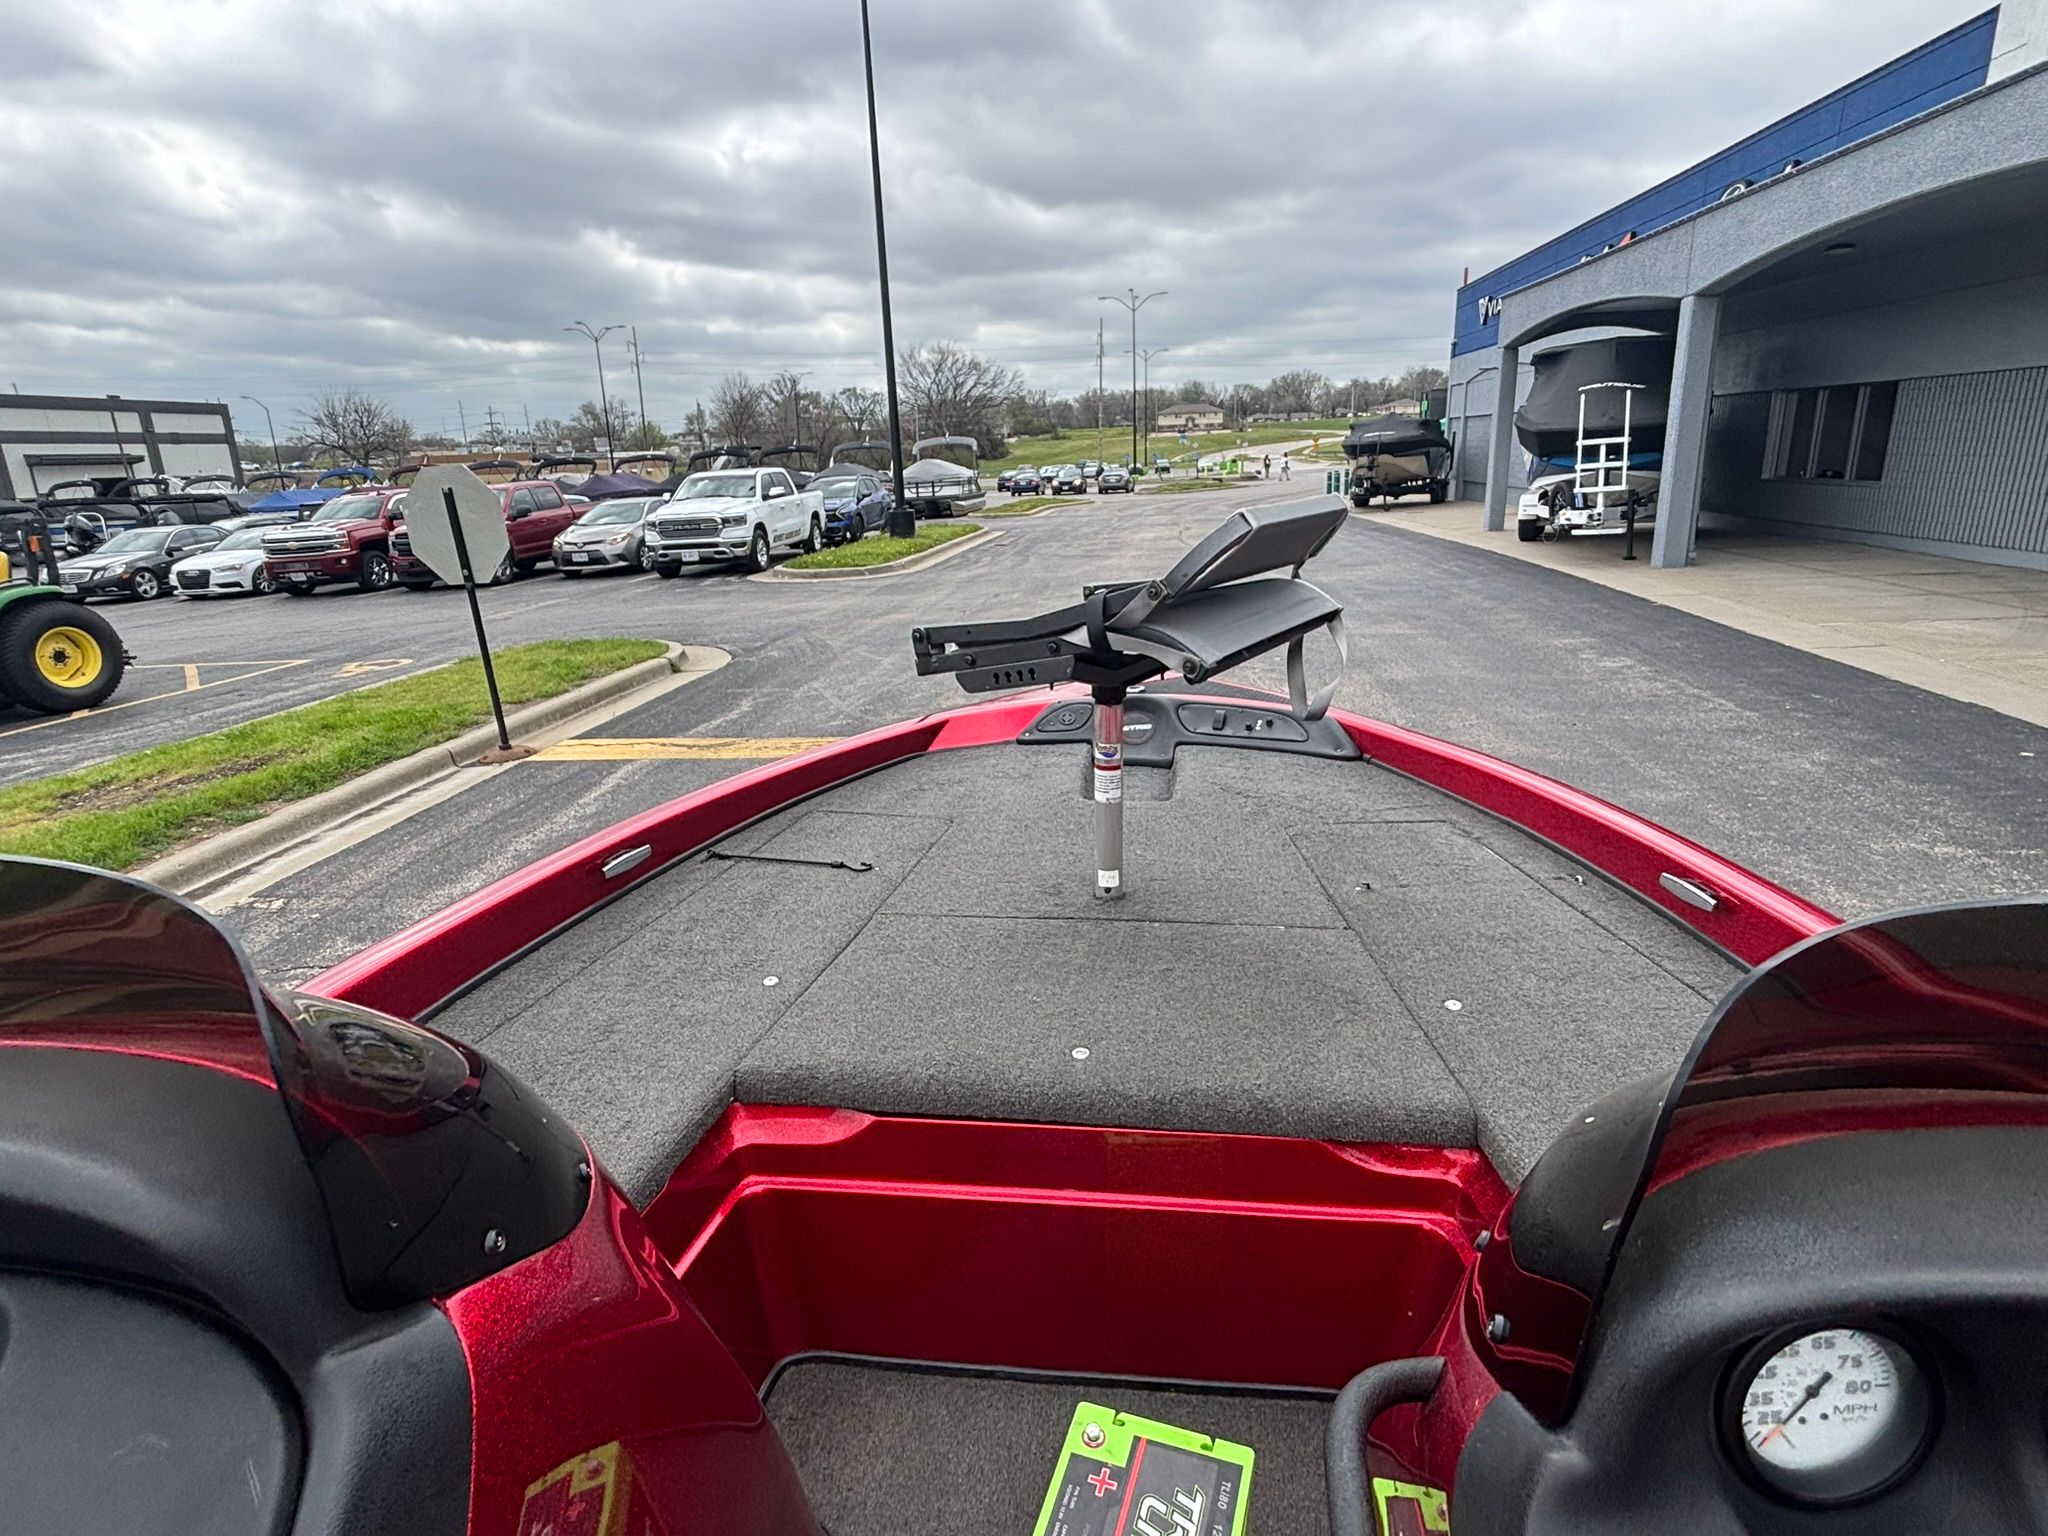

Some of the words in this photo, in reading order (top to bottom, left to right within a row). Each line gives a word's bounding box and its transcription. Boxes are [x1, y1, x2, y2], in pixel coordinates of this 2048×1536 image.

[1811, 1335, 1836, 1350] 65
[1837, 1354, 1863, 1369] 75
[1757, 1365, 1778, 1379] 5
[1845, 1380, 1872, 1394] 80
[1748, 1391, 1775, 1407] 35
[1833, 1403, 1878, 1415] MPH
[1757, 1410, 1783, 1425] 25
